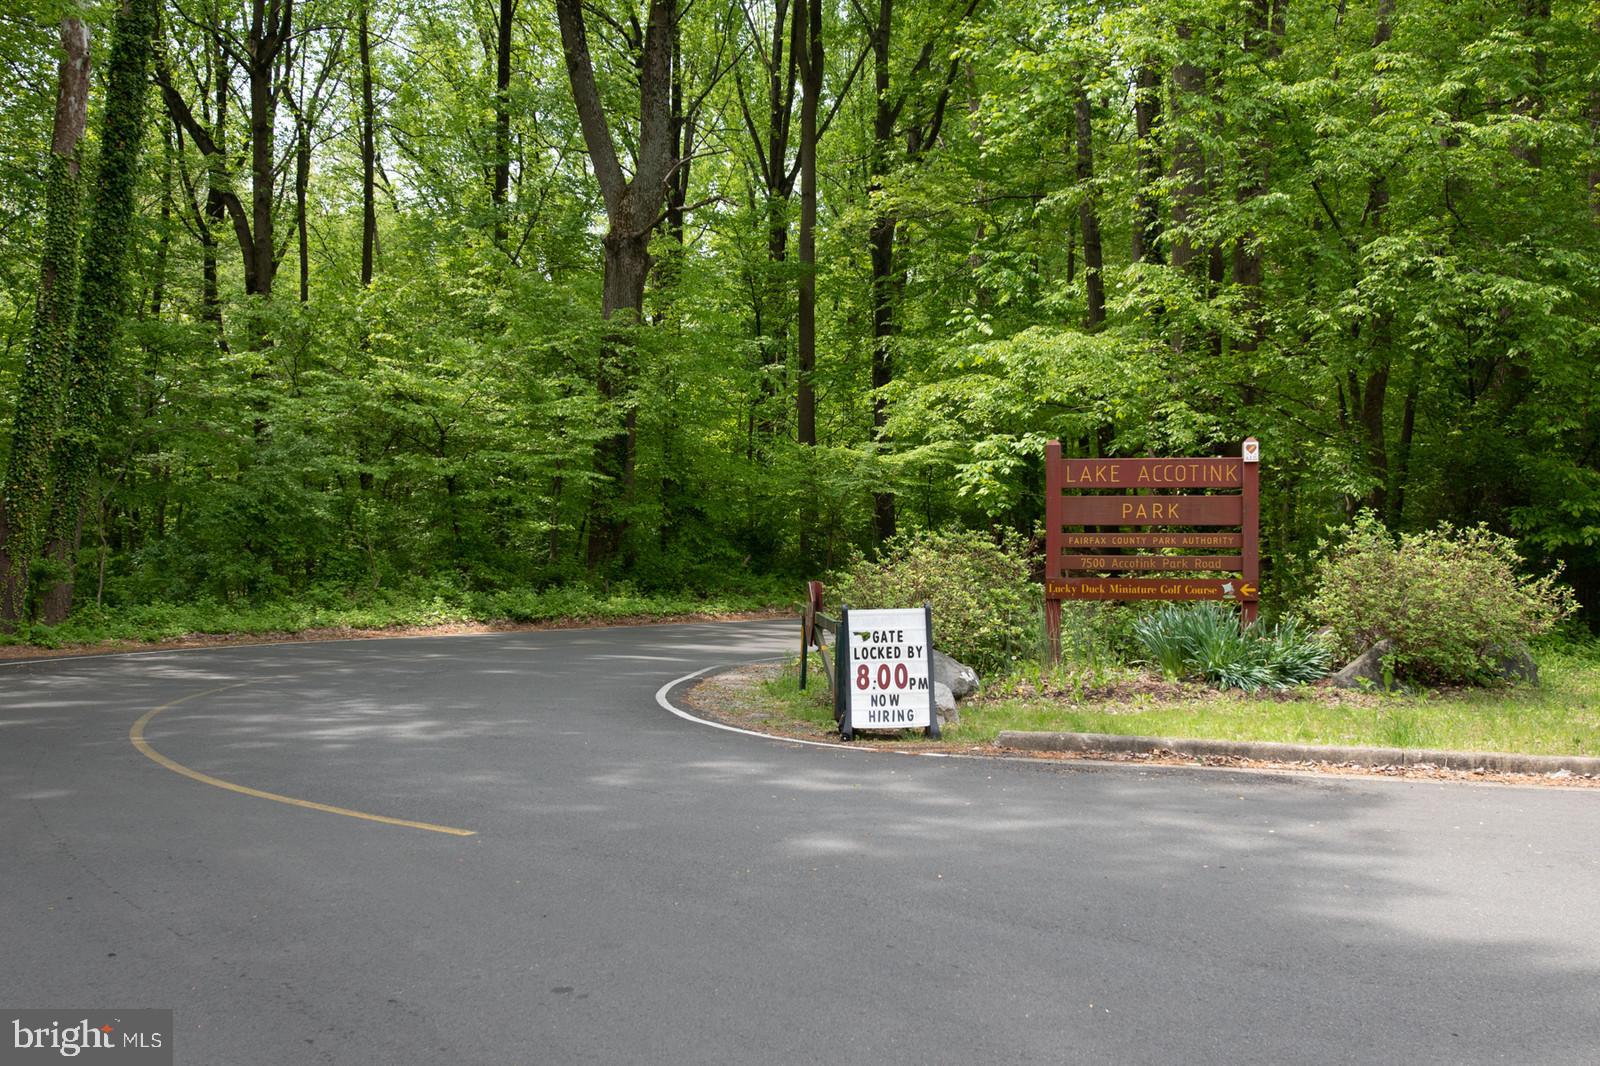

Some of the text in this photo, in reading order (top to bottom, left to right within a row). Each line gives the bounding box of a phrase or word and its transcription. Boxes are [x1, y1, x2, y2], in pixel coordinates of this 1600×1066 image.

[1066, 464, 1238, 483] LAKE ACCOTINK
[1122, 503, 1180, 519] PARK
[1068, 536, 1234, 545] FAIRFAX COUNTY PARK AUTHORITY
[1080, 558, 1221, 568] 7500 Accotink Park Road
[1049, 583, 1218, 598] Lucky Duck Miniature Golf Course
[872, 630, 904, 643] GATE
[854, 646, 923, 660] LOCKED BY
[870, 694, 900, 707] NOW
[868, 709, 914, 723] HIRING
